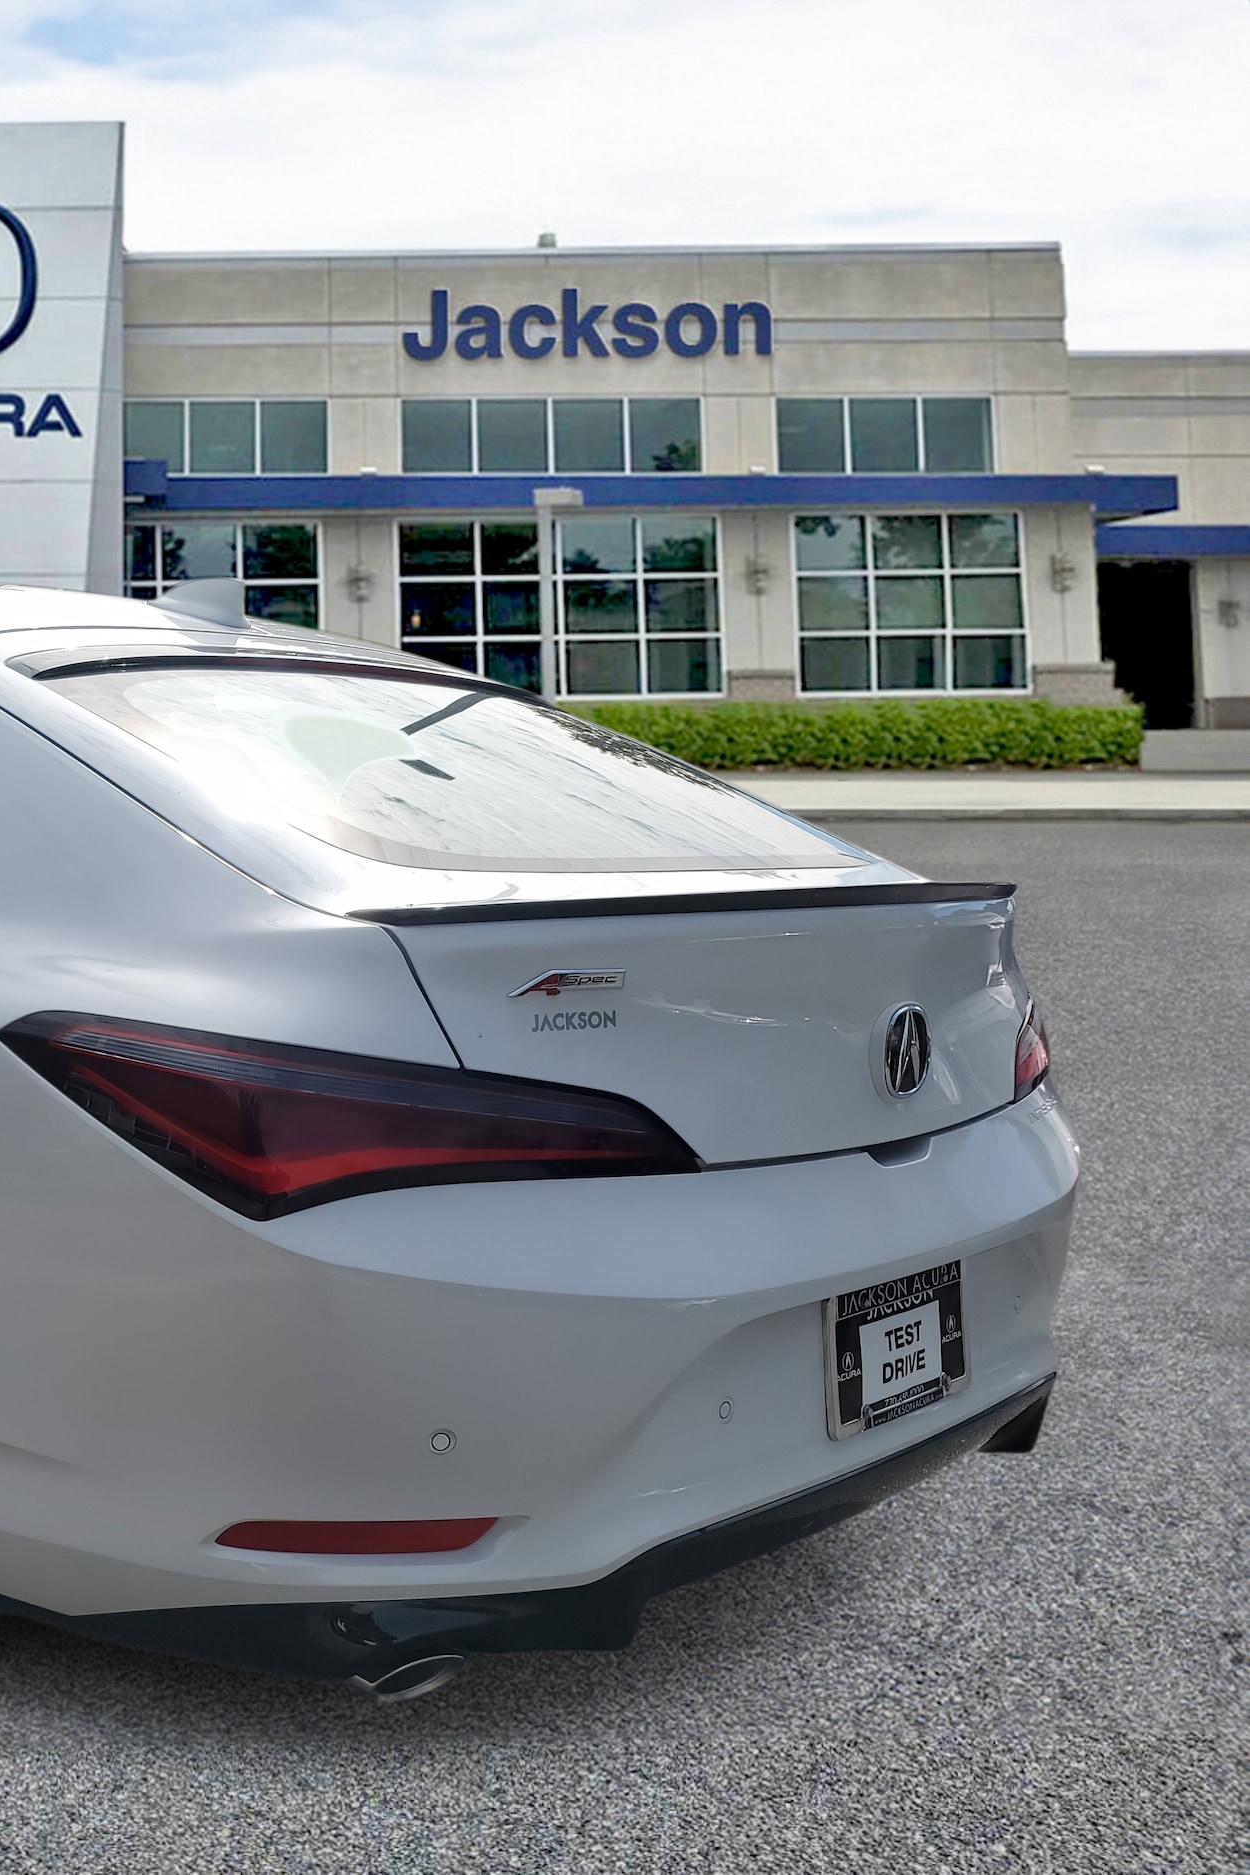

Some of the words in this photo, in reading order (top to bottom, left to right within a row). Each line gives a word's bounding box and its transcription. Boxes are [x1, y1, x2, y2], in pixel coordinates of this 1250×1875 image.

[403, 288, 772, 361] Jackson
[531, 1010, 616, 1033] JACKSON
[842, 1278, 908, 1317] JACKSON
[912, 1262, 959, 1293] ACURA
[884, 1320, 922, 1352] TEST
[941, 1330, 962, 1344] ACURA
[837, 1368, 862, 1382] ACURA
[882, 1348, 926, 1384] DRIVE
